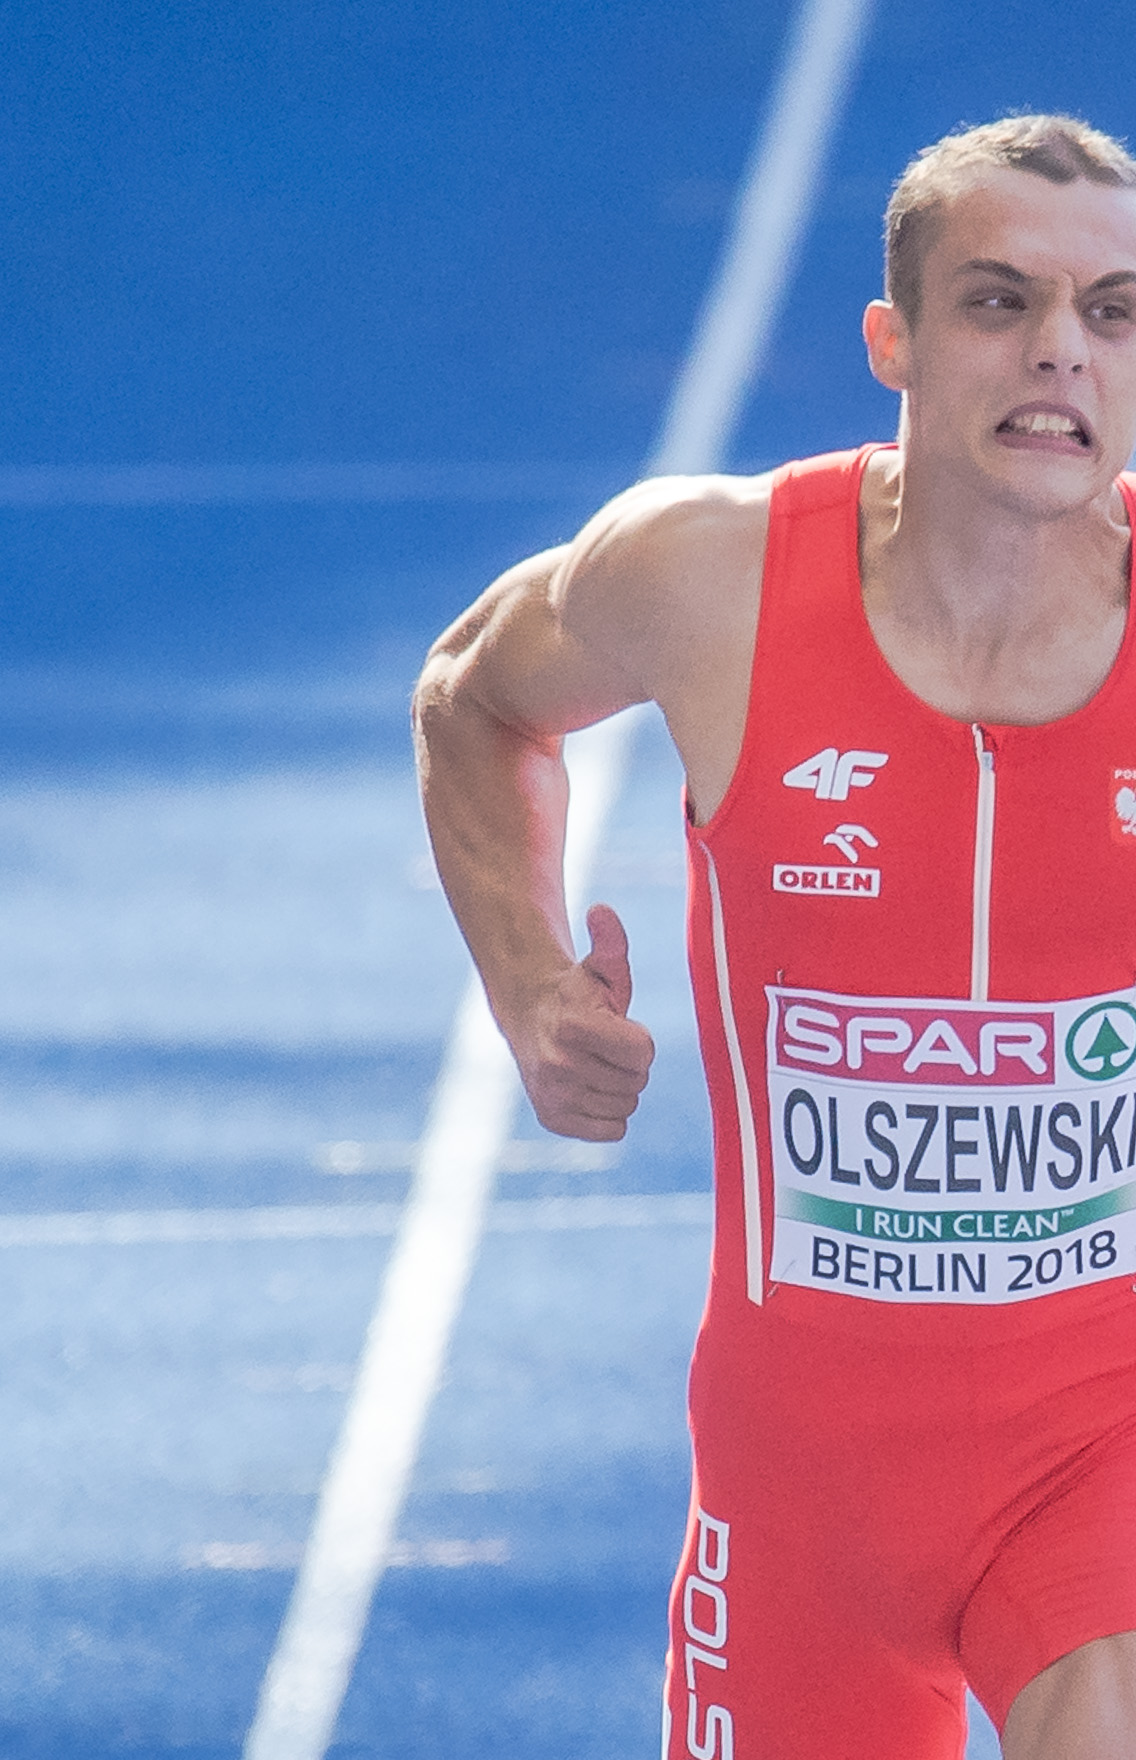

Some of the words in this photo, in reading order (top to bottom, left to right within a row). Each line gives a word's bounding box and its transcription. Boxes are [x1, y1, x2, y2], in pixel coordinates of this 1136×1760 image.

[779, 870, 872, 891] ORLEN
[783, 1005, 1048, 1075] SPAR
[855, 1208, 863, 1231] I
[873, 1212, 943, 1236] RUN
[811, 1237, 986, 1293] BERLIN
[1008, 1230, 1117, 1292] 2018
